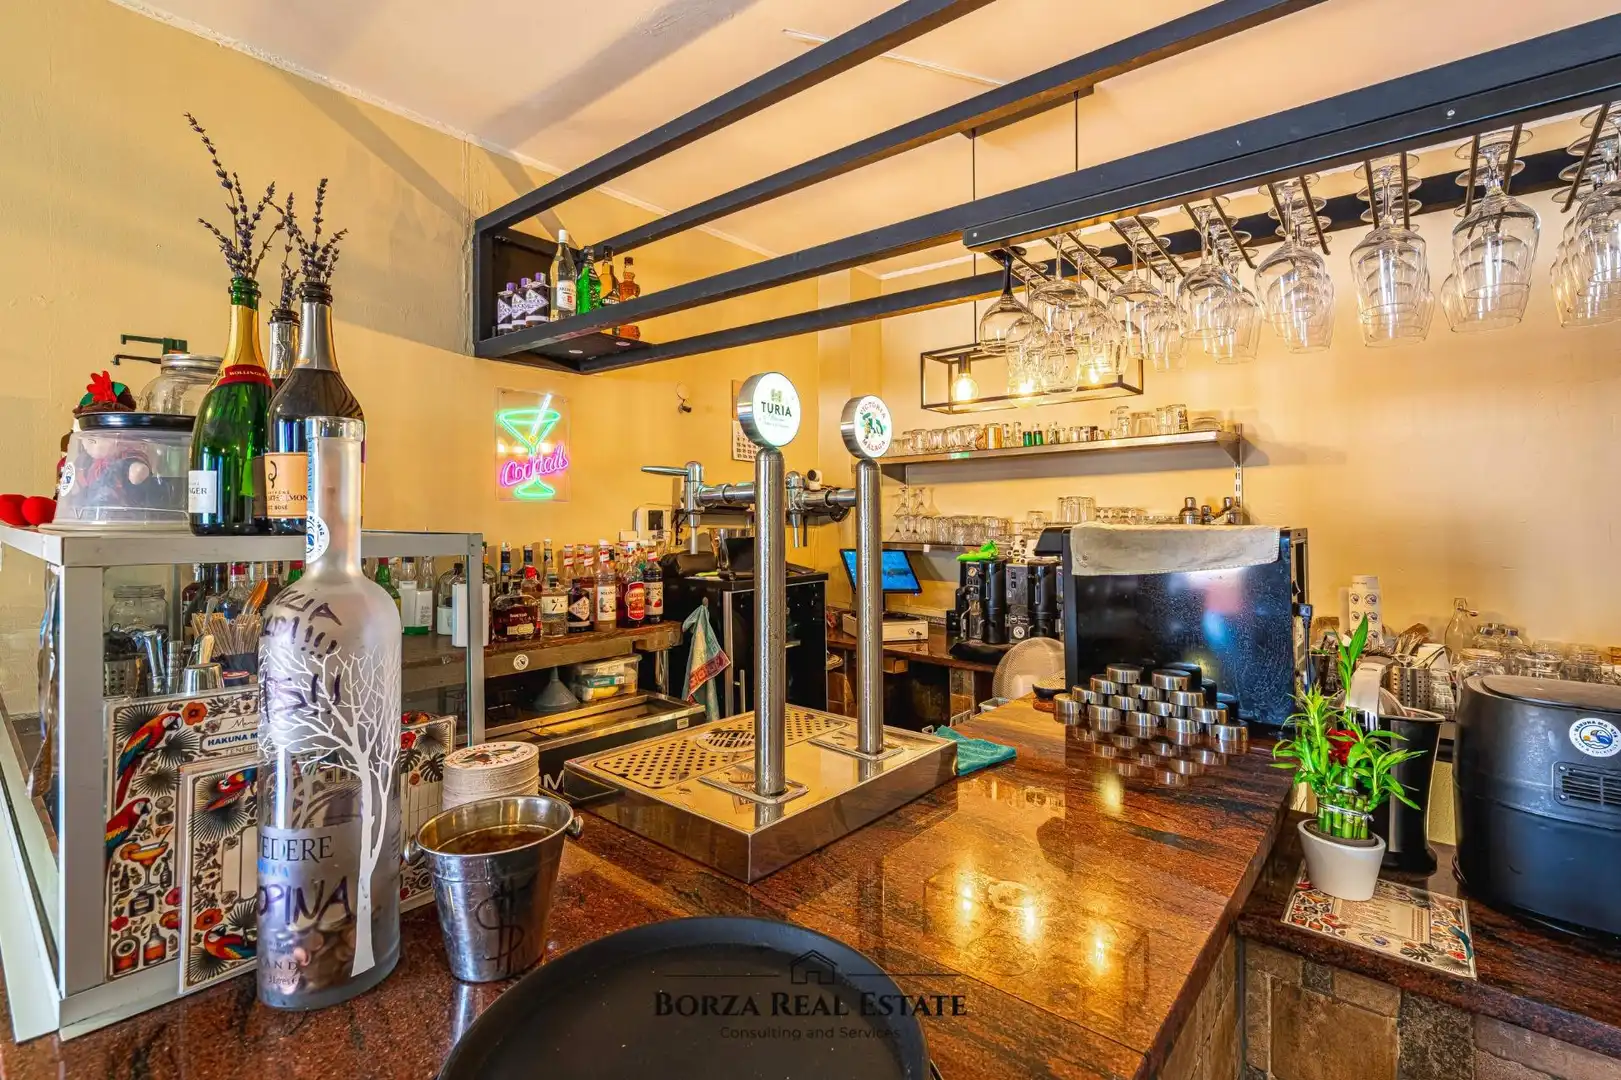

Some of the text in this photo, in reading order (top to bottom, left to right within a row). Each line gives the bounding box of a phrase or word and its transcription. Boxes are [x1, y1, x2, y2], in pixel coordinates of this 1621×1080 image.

[761, 401, 792, 417] TURIA
[501, 443, 569, 487] Cocktails
[207, 734, 248, 747] HAKUNA
